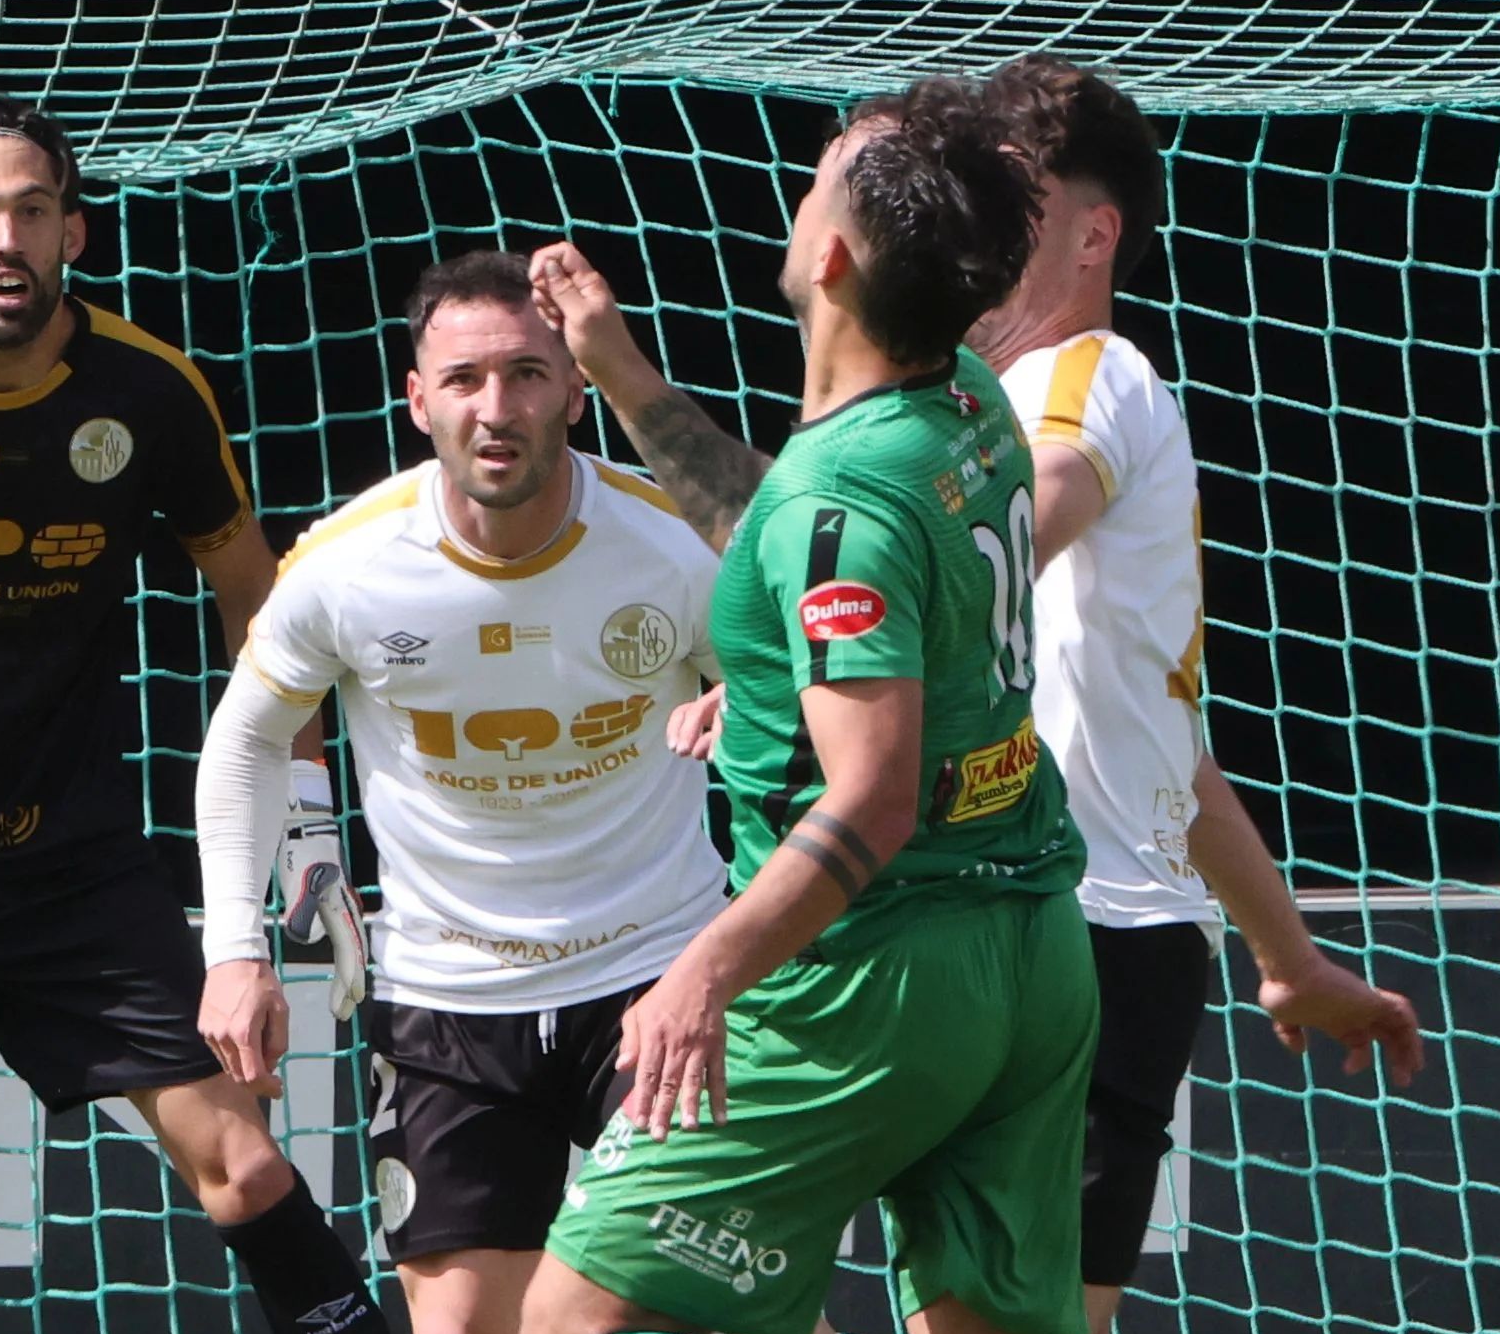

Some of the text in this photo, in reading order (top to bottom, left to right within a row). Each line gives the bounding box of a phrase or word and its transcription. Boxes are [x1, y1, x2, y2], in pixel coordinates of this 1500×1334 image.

[803, 599, 873, 625] Dulma
[384, 655, 426, 665] umbro
[508, 774, 546, 790] DE
[648, 1202, 787, 1276] TELENO
